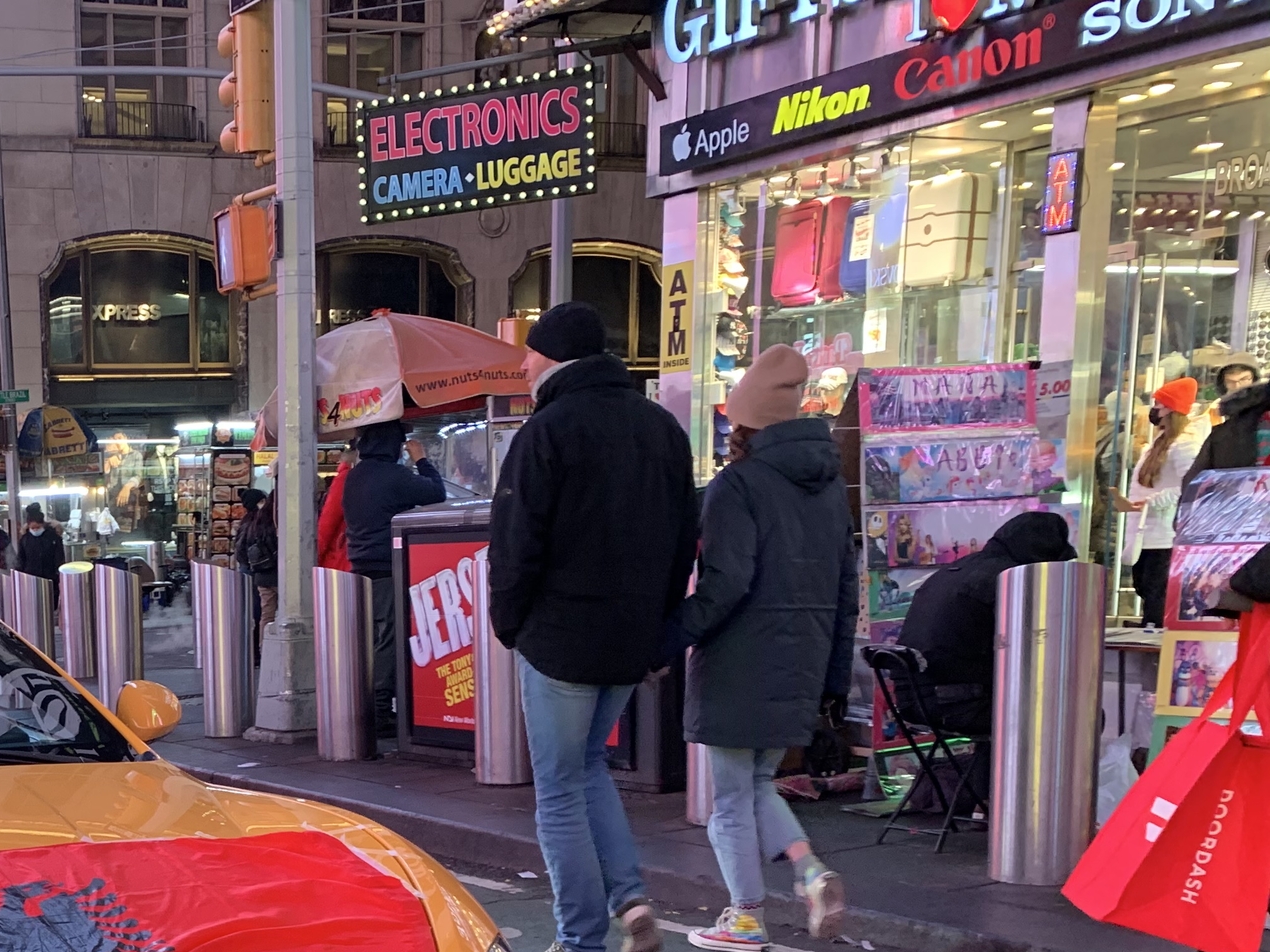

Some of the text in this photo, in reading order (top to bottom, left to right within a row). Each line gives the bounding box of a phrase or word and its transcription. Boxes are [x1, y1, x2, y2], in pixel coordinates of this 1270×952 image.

[663, 0, 866, 63] GIF
[1081, 0, 1247, 46] SO
[369, 86, 581, 163] ELECTRONICS
[772, 82, 871, 136] Nikon
[694, 119, 750, 158] Apple
[373, 147, 582, 205] CAMERA LUGGAGE
[1048, 157, 1069, 228] ATM
[667, 268, 688, 357] ATM
[663, 357, 690, 369] INSIDE
[436, 663, 451, 678] THE
